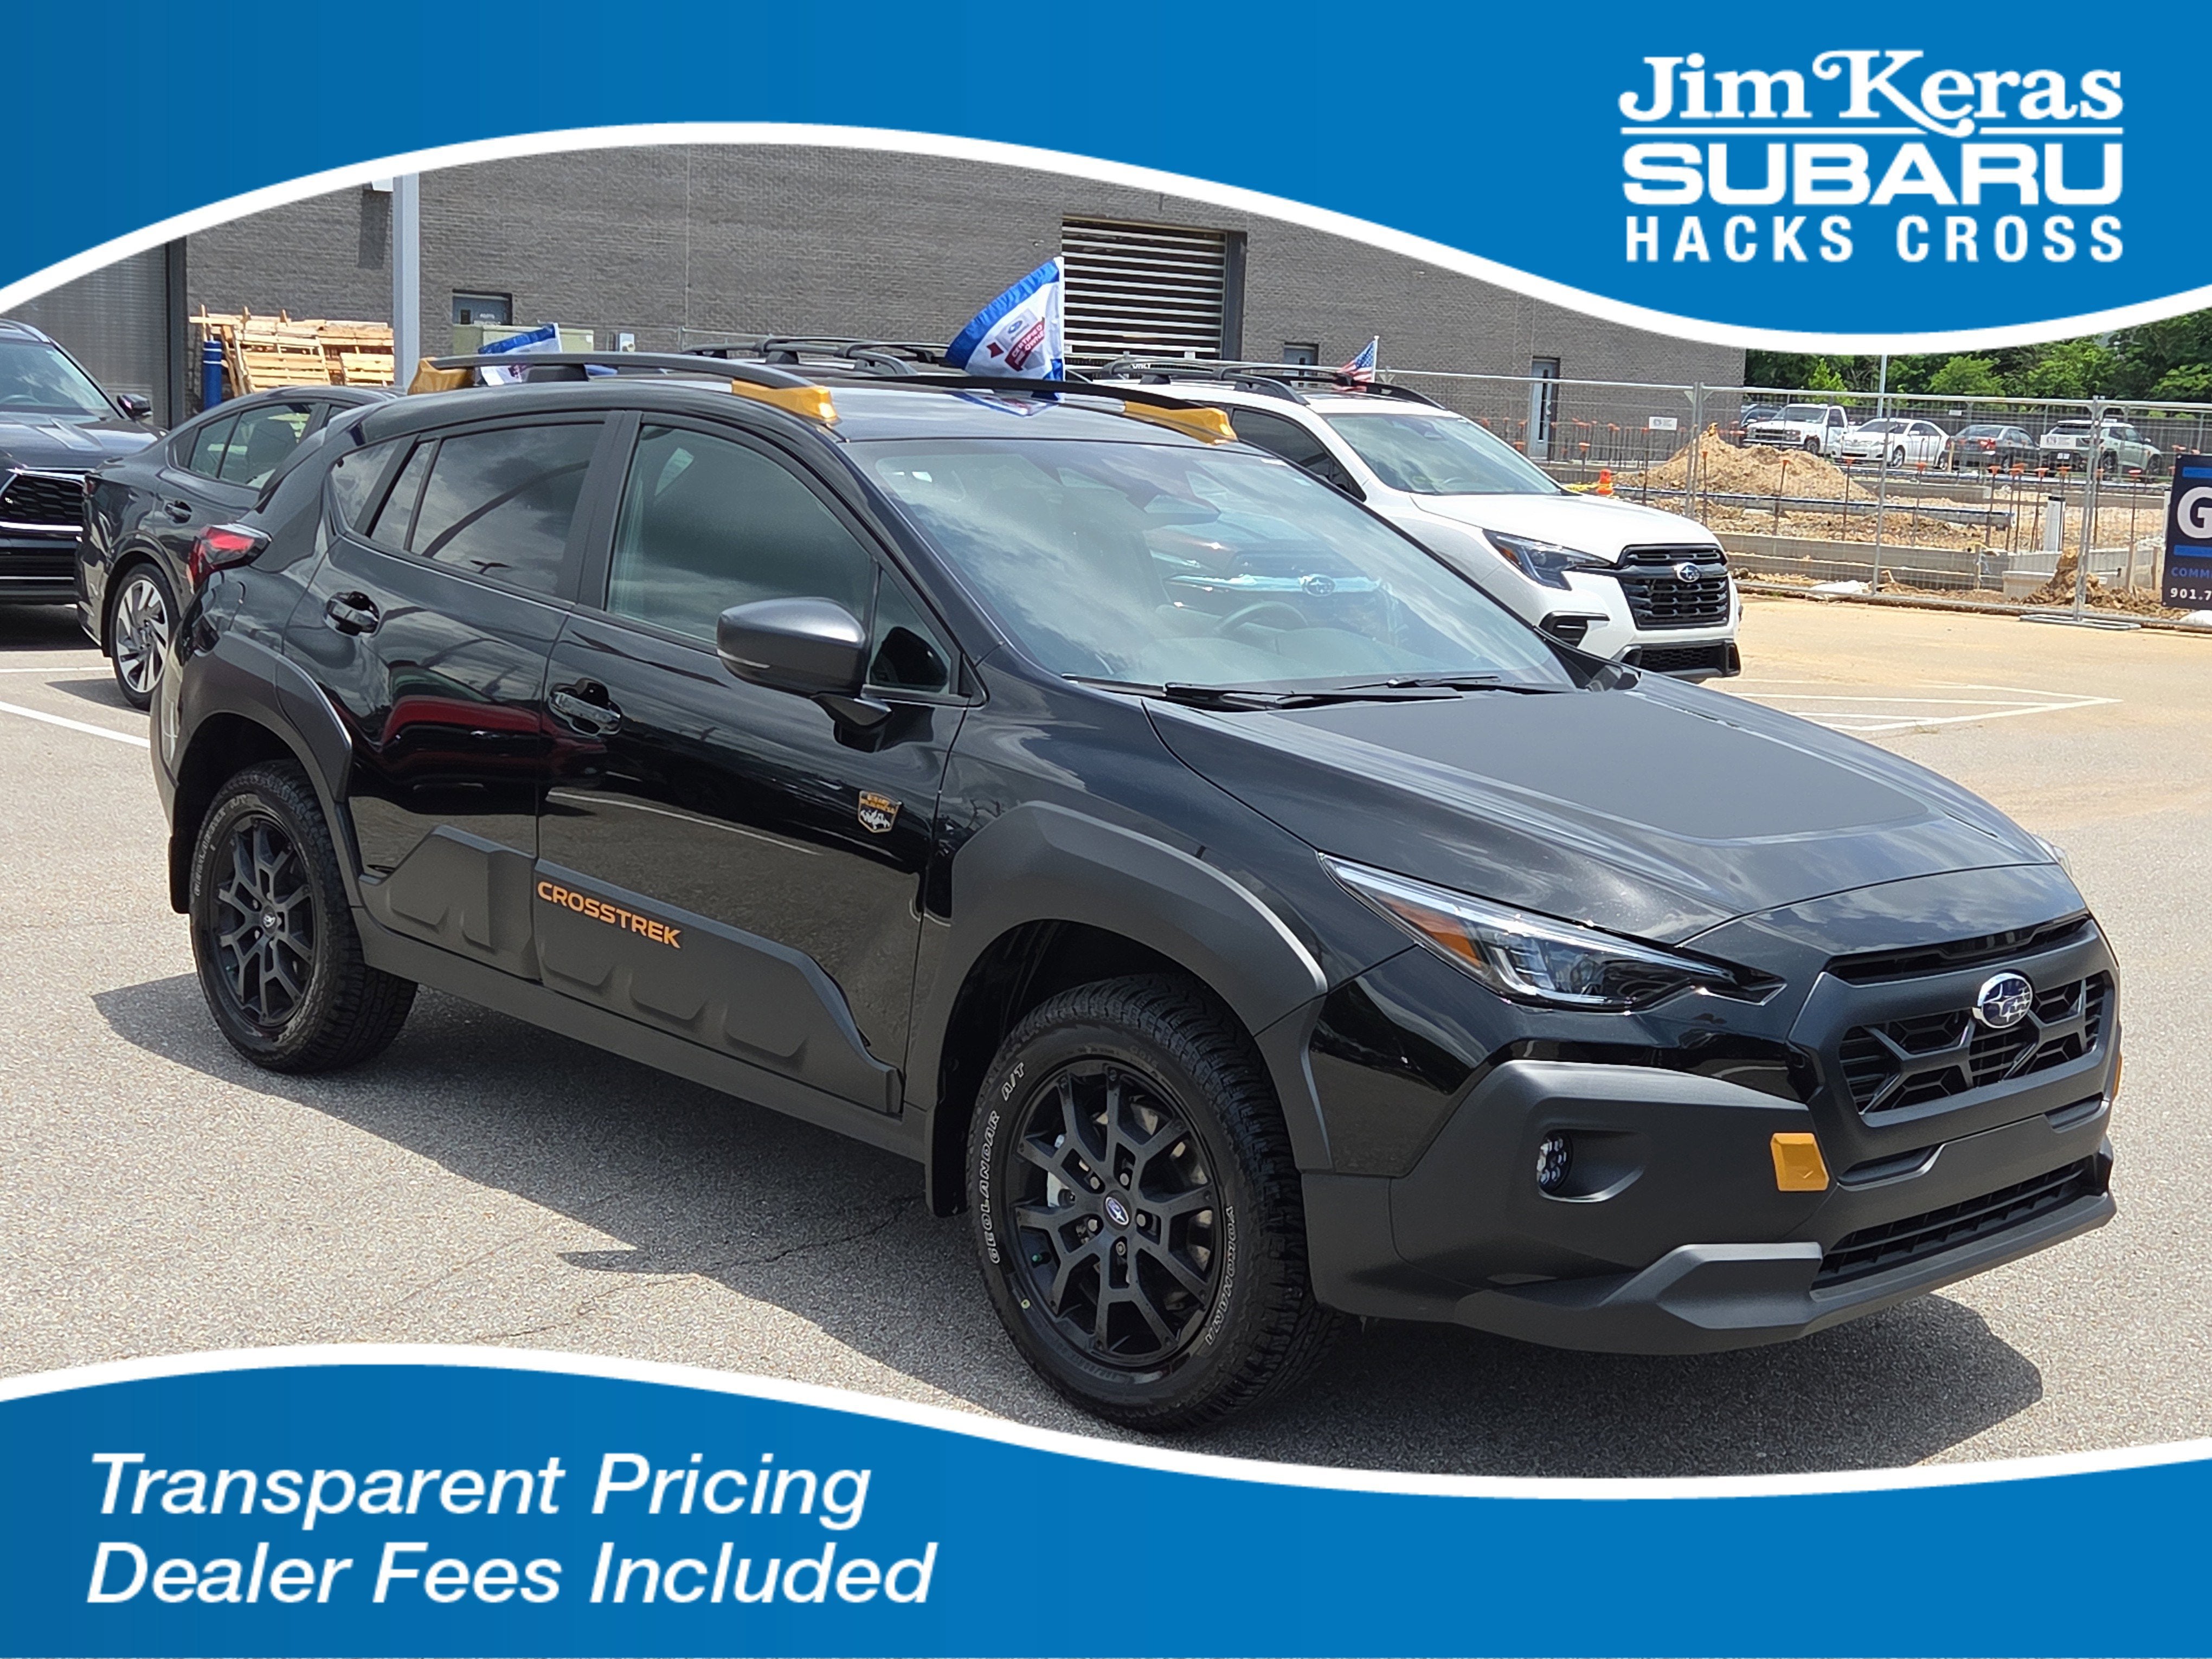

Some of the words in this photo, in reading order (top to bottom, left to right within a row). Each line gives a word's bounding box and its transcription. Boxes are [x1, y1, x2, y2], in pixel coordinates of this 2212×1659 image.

[2171, 566, 2212, 579] COMM
[537, 881, 681, 949] CROSSTREK
[979, 1110, 1000, 1264] GEOLANDAR
[1001, 1062, 1026, 1101] A/T
[1205, 1205, 1237, 1346] YOKOHAMA
